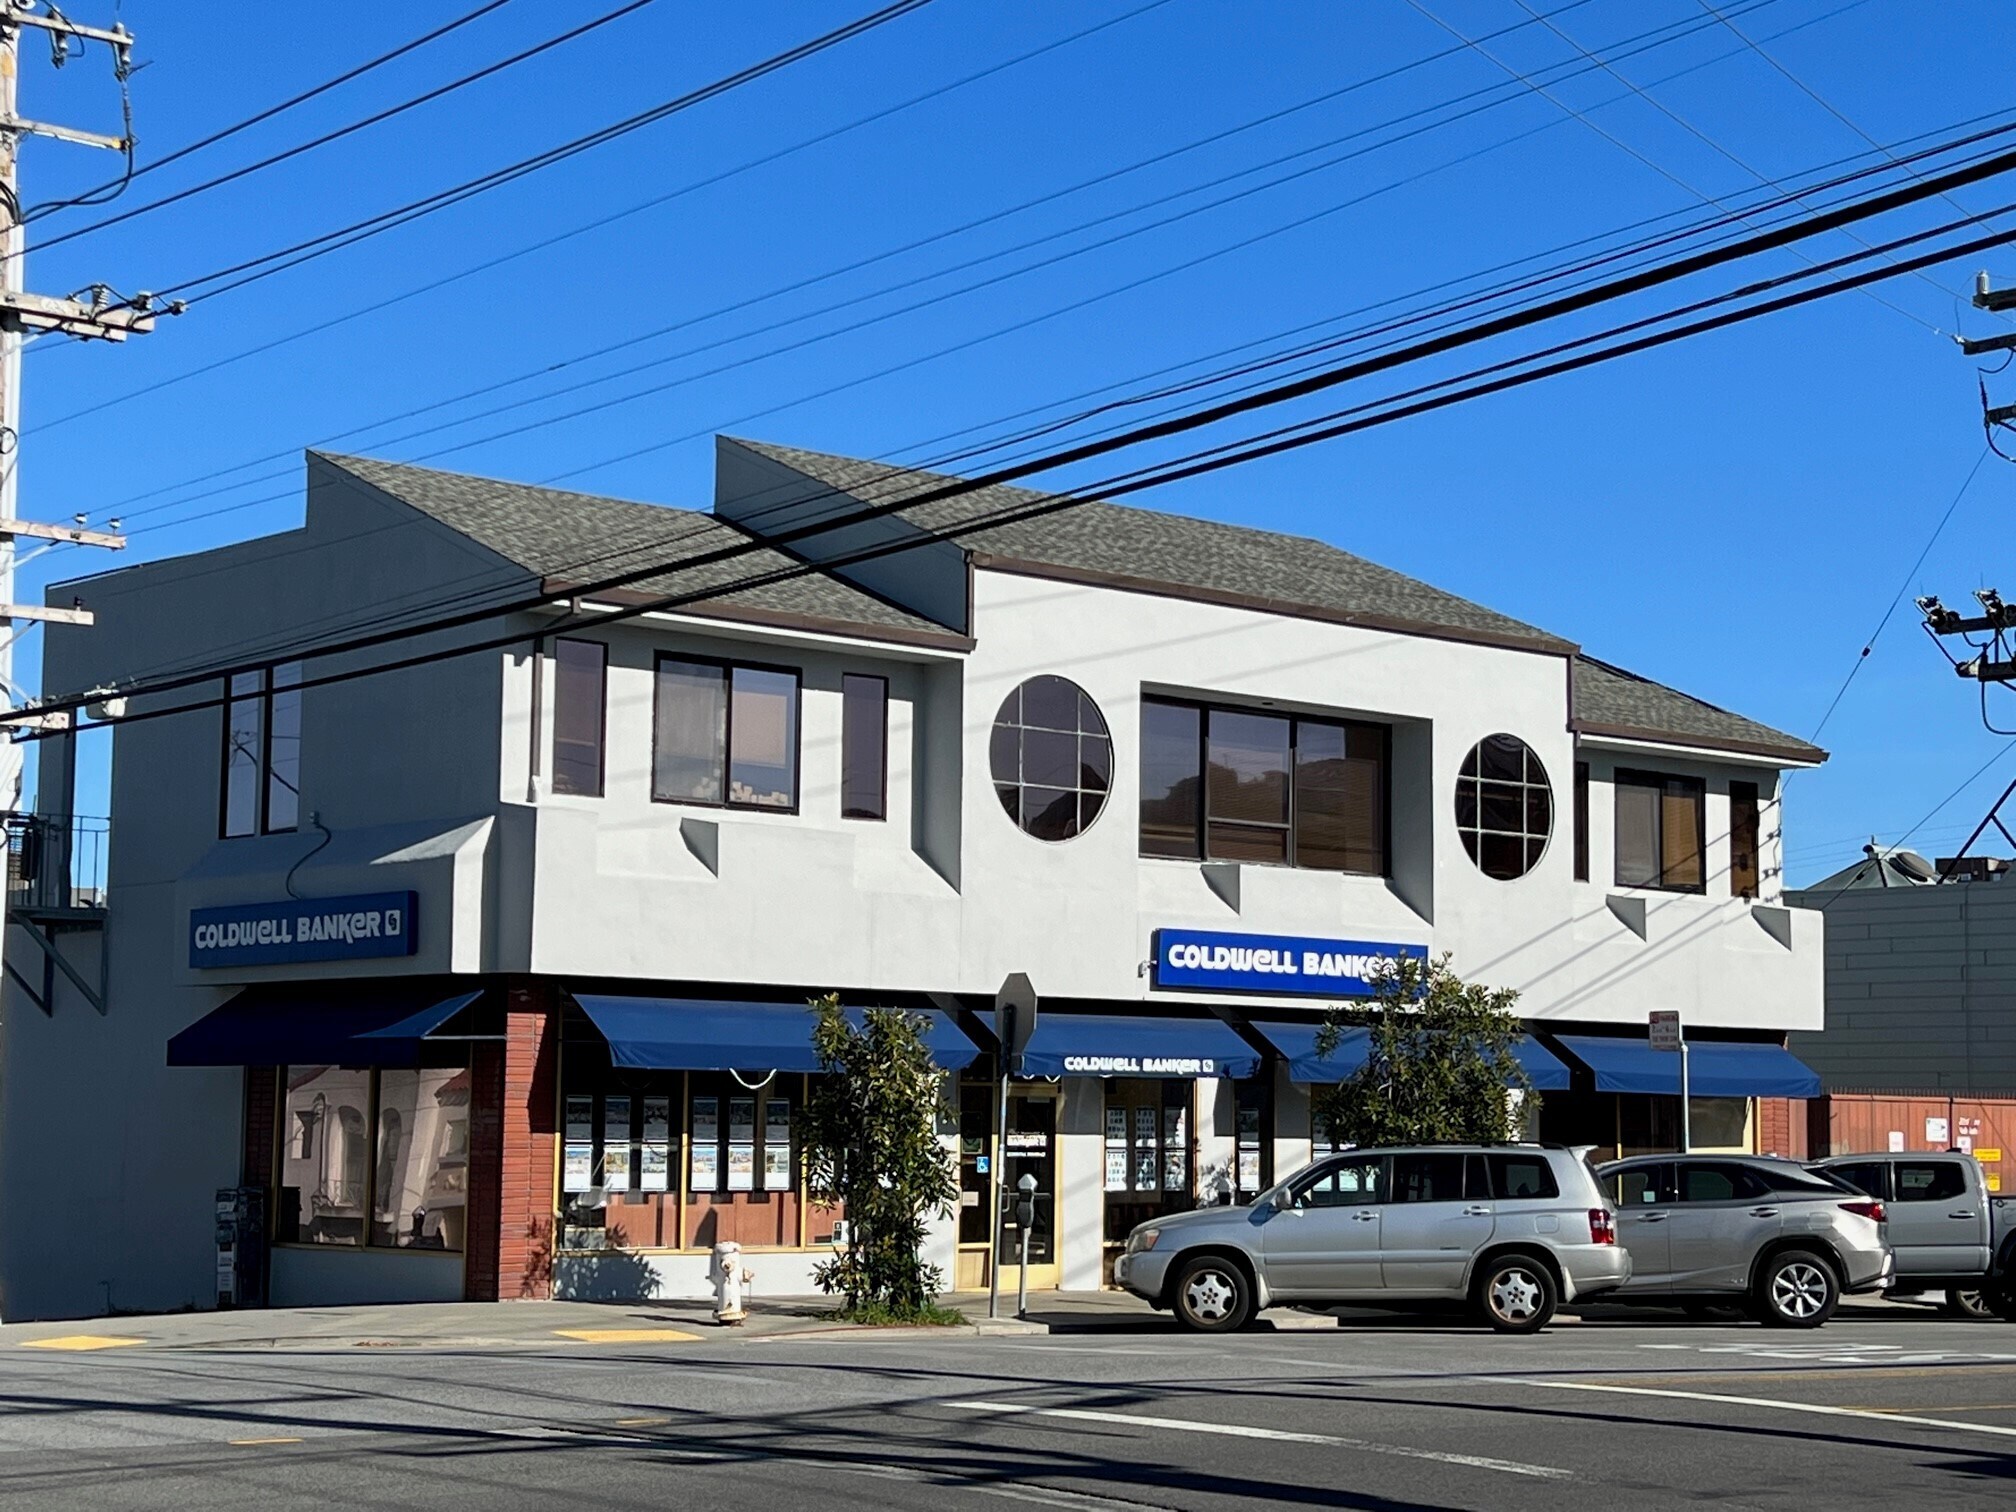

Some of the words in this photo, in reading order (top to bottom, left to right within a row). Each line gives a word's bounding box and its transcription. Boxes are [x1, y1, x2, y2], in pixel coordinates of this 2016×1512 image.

[195, 919, 292, 949] COLDWELL
[297, 911, 381, 944] BANKER
[1168, 944, 1298, 974] COLDWELL
[1064, 1056, 1140, 1072] COLDWELL
[1142, 1058, 1201, 1075] BANKER
